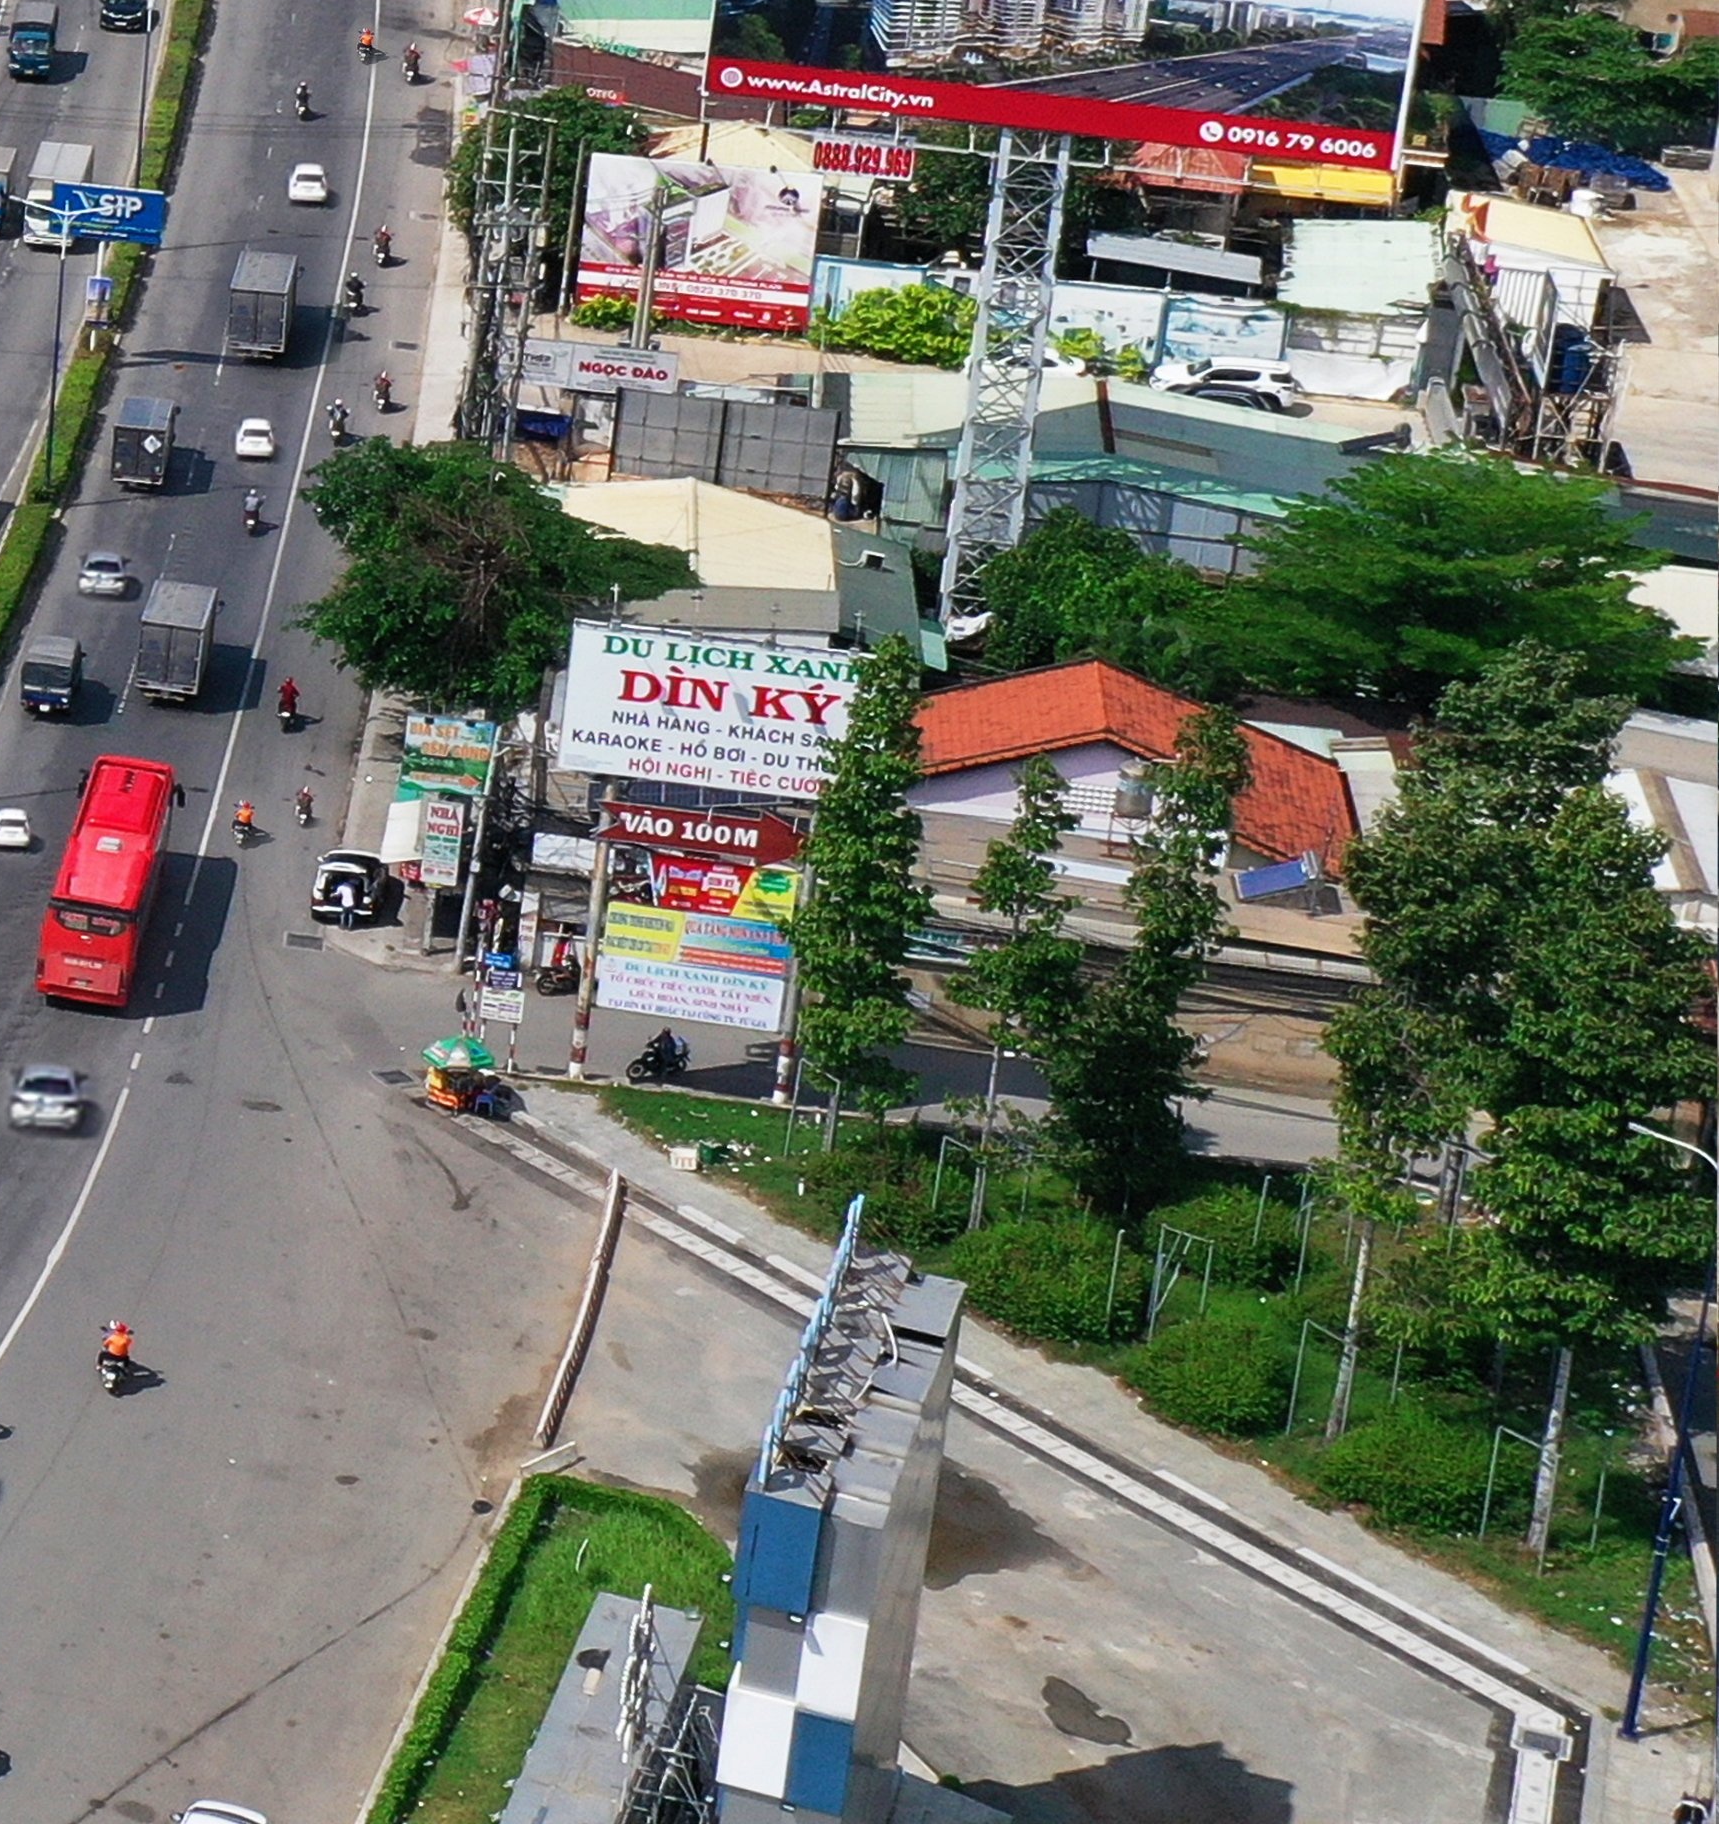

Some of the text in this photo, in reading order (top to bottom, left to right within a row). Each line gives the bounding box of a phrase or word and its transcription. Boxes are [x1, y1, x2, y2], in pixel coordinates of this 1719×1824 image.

[747, 75, 935, 108] www.AstralCity.vn
[1227, 126, 1377, 158] 0916 79 6006
[603, 635, 655, 658] DU
[666, 643, 755, 669] LỊCH
[618, 666, 841, 725] DÌN KÝ
[613, 710, 650, 726] NHÀ
[657, 714, 710, 735] HÀNG
[728, 725, 795, 747] KHÁCH
[572, 728, 662, 753] KARAOKE
[680, 738, 708, 757] HỒ
[714, 746, 746, 764] BƠI
[763, 753, 790, 770] DU
[628, 757, 661, 772] HỘI
[666, 763, 712, 783] NGHỊ
[730, 770, 772, 789] TIỆC
[620, 810, 759, 847] VÀO 100M
